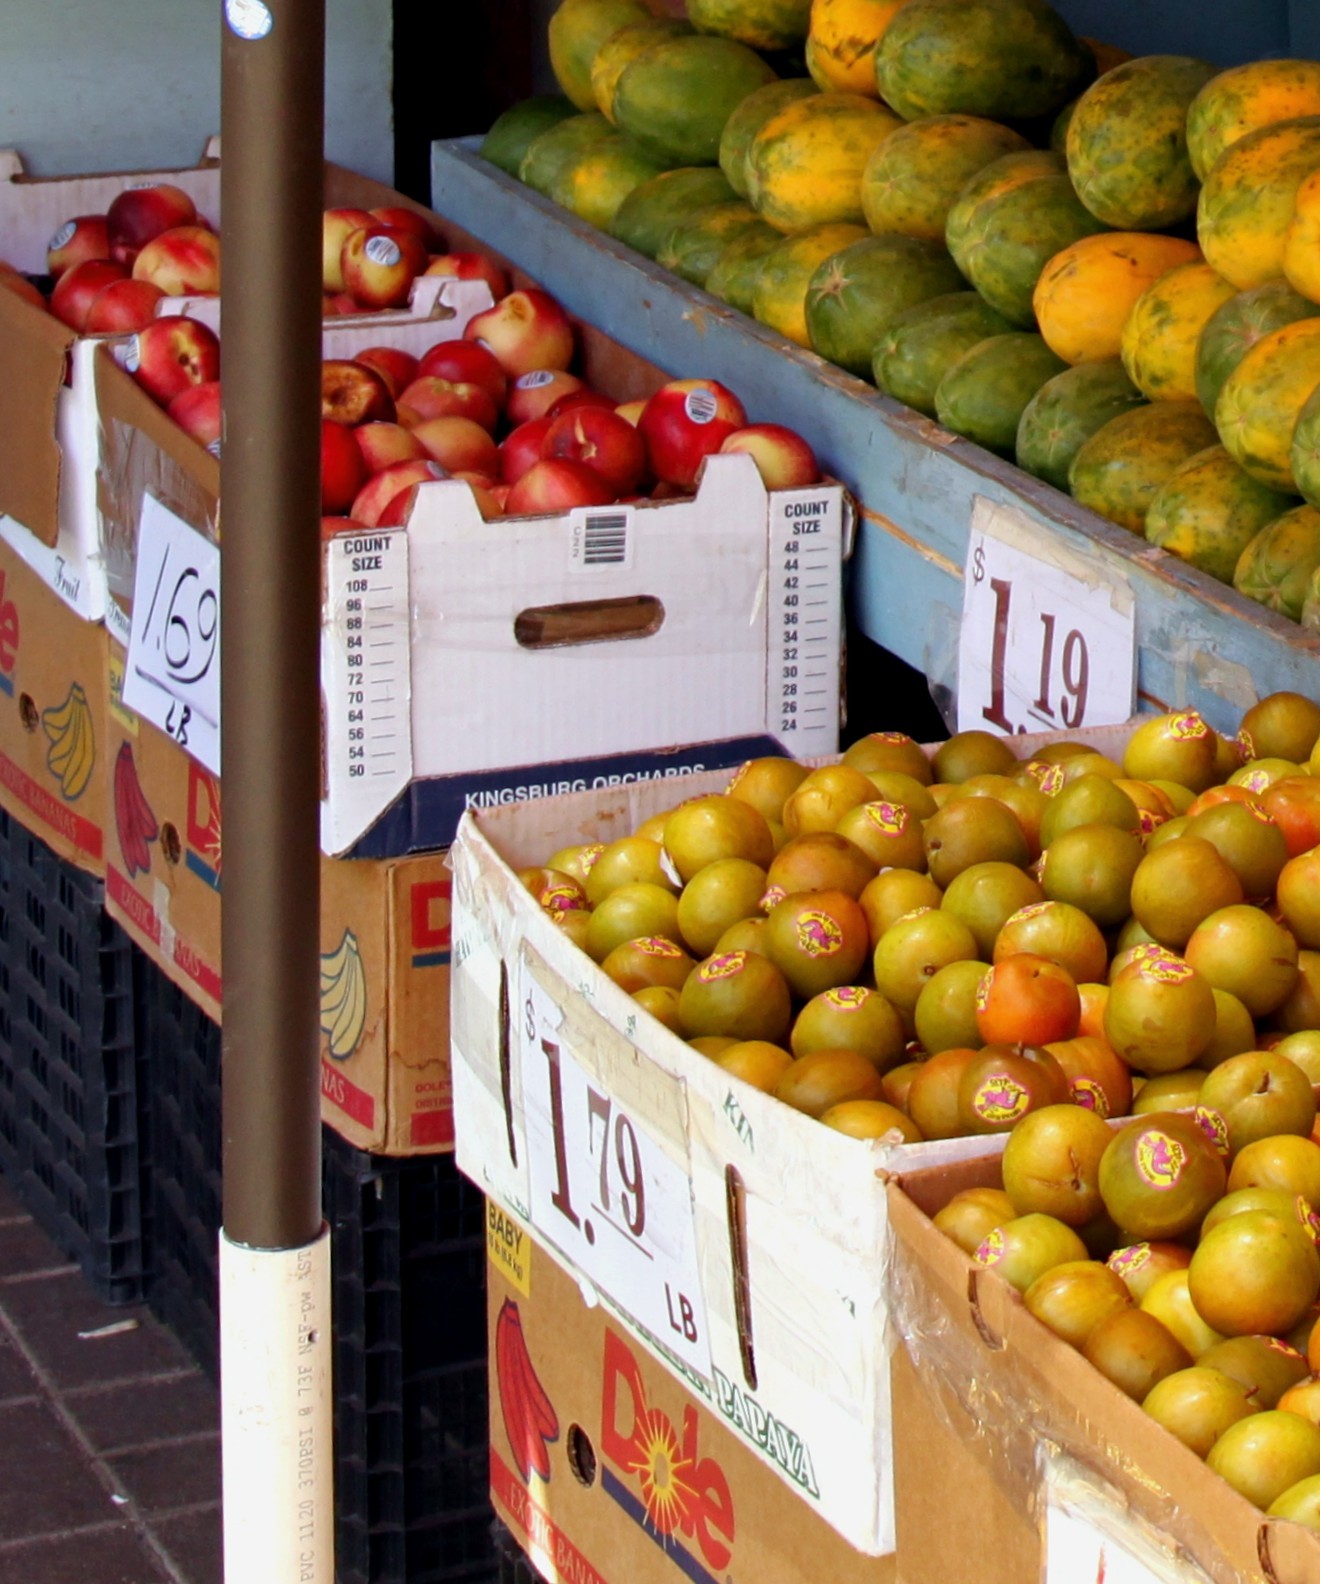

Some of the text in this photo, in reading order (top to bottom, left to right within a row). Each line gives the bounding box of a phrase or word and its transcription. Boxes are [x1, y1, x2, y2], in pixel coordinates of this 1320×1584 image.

[784, 501, 829, 518] COUNT
[793, 520, 821, 535] SIZE
[344, 537, 392, 554] COUNT
[784, 542, 798, 553] 48
[352, 556, 382, 571] SIZE
[784, 559, 798, 571] 44
[346, 580, 367, 592] 108
[783, 577, 798, 588] 42
[346, 599, 361, 611] 96
[783, 595, 798, 607] 40
[142, 543, 218, 684] 1.69
[783, 613, 797, 624] 36
[347, 618, 362, 629] 88
[347, 637, 362, 648] 84
[782, 631, 797, 642] 34
[347, 655, 362, 666] 80
[782, 649, 797, 660] 32
[782, 667, 796, 678] 30
[348, 673, 363, 685] 72
[782, 685, 796, 696] 28
[348, 692, 363, 704] 70
[781, 702, 796, 714] 26
[348, 710, 363, 722] 64
[781, 720, 796, 731] 24
[348, 728, 364, 739] 56
[349, 746, 364, 758] 54
[349, 765, 364, 776] 50
[465, 779, 586, 809] KINGSBURG
[489, 1202, 523, 1255] BABY
[665, 1282, 698, 1344] LB
[715, 1365, 821, 1499] PAPAYA
[601, 1326, 736, 1571] Dole
[298, 1426, 314, 1490] 370PSI
[299, 1499, 315, 1541] 1120
[300, 1550, 315, 1583] PVC
